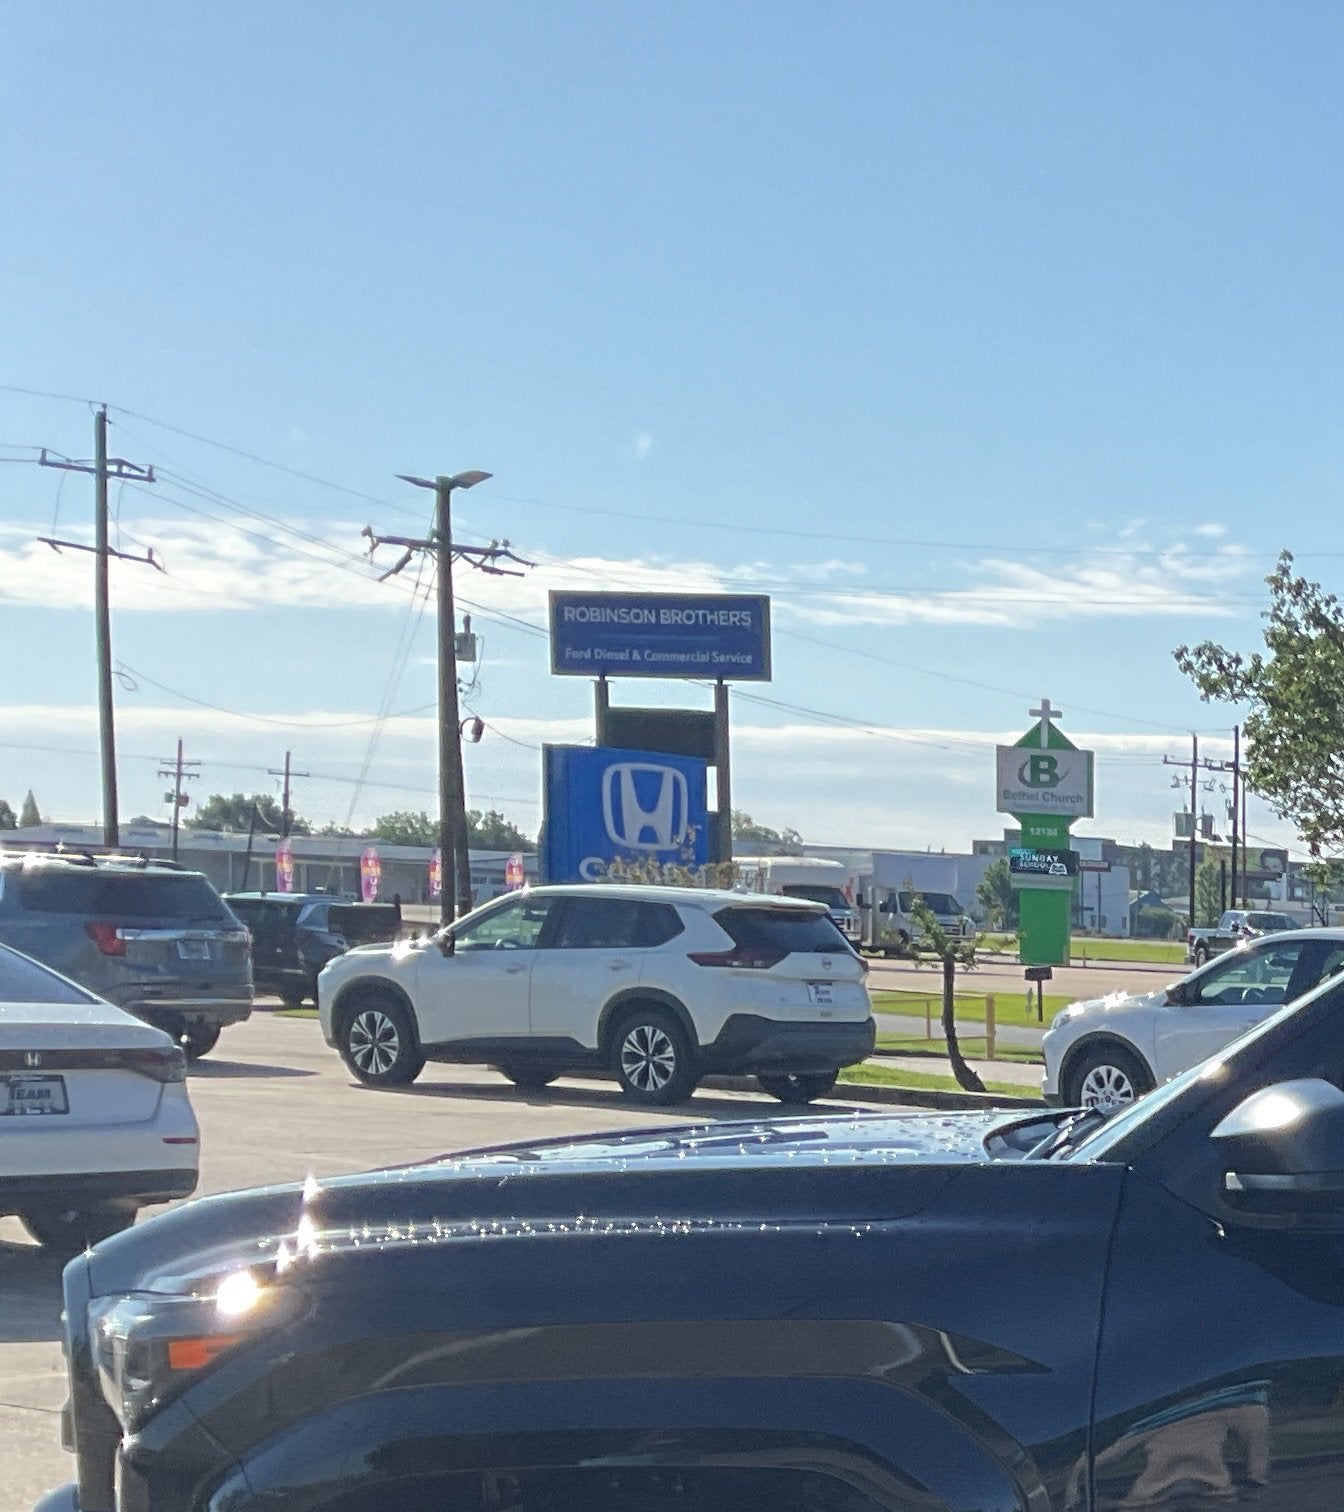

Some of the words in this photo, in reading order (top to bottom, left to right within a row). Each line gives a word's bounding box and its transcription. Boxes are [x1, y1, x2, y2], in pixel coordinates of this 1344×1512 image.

[563, 606, 655, 624] ROBINSON
[659, 609, 752, 627] BROTHERS
[594, 648, 630, 661] Diesel
[631, 652, 642, 662] &
[644, 651, 710, 664] Commercial
[711, 652, 753, 665] Service
[1030, 754, 1059, 788] B
[1003, 789, 1039, 801] Bethel
[1042, 791, 1084, 804] Church
[1019, 854, 1060, 864] SUNDAY
